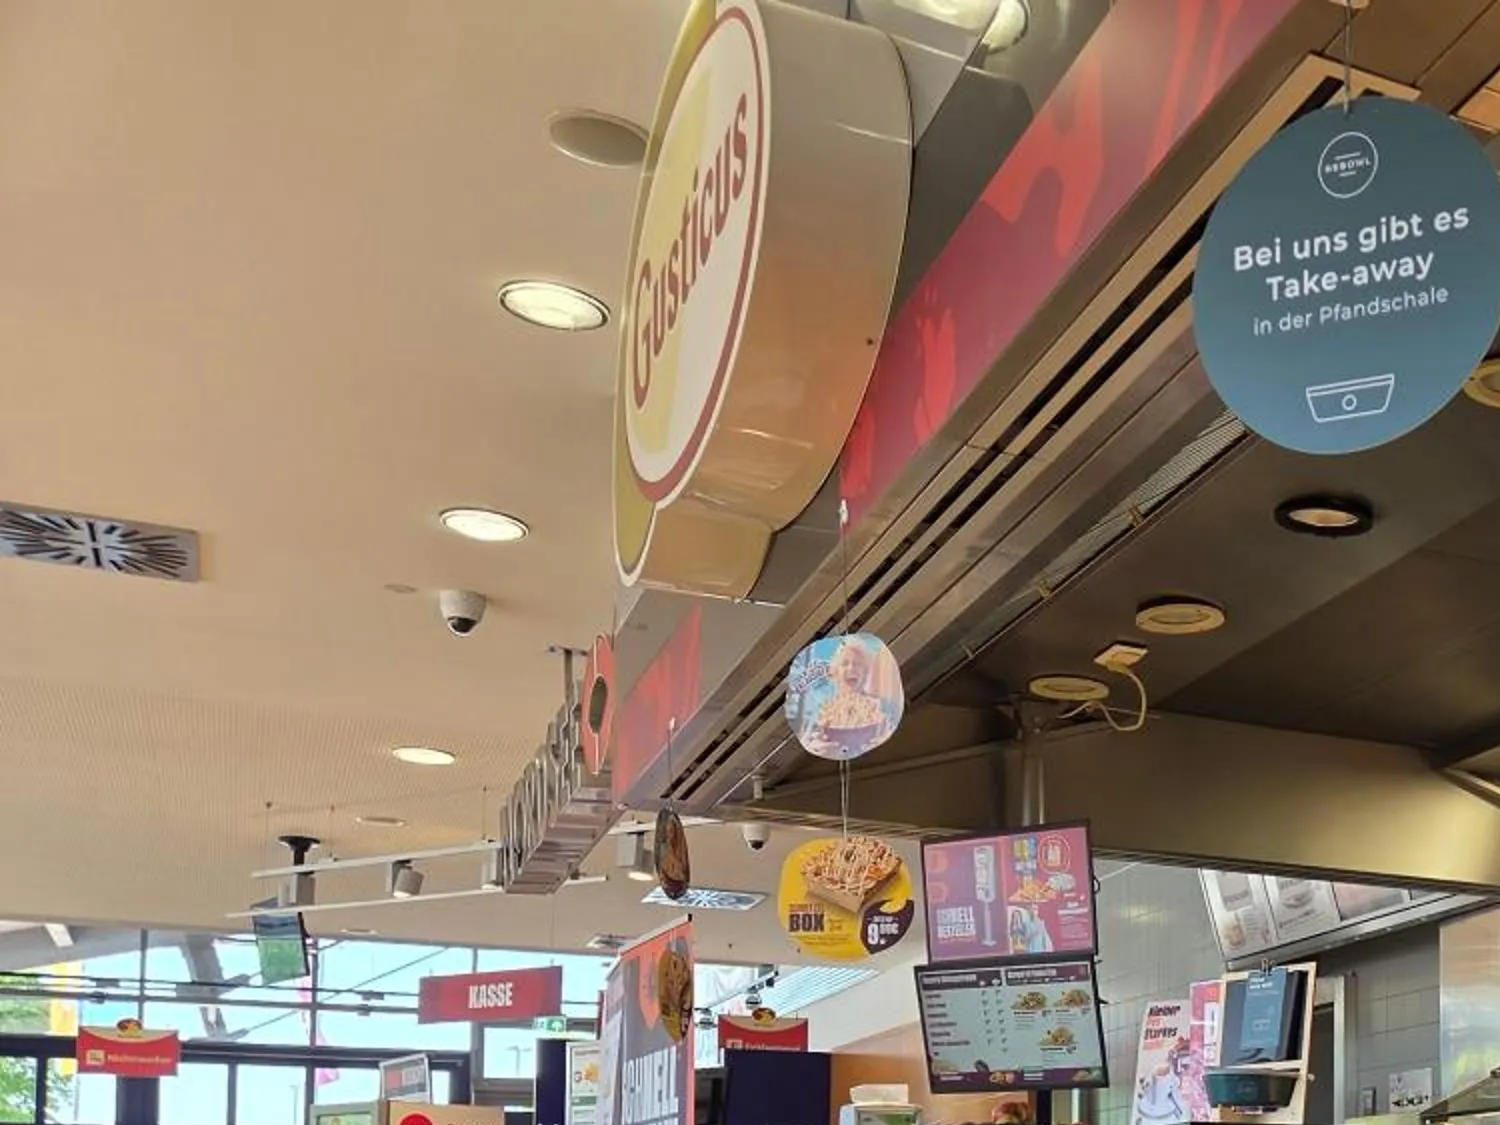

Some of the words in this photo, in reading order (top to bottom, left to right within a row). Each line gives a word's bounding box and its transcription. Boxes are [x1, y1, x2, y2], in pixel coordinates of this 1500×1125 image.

[631, 93, 749, 414] Gusticus
[1233, 238, 1282, 272] Bei
[1292, 230, 1349, 261] uns
[1358, 213, 1423, 252] gibt
[1433, 206, 1470, 233] es
[1265, 252, 1435, 302] Take-away
[1253, 317, 1273, 336] in
[1278, 310, 1313, 332] der
[1319, 286, 1450, 324] Pfandschale
[788, 913, 825, 933] BOX
[468, 982, 514, 1010] KASSE
